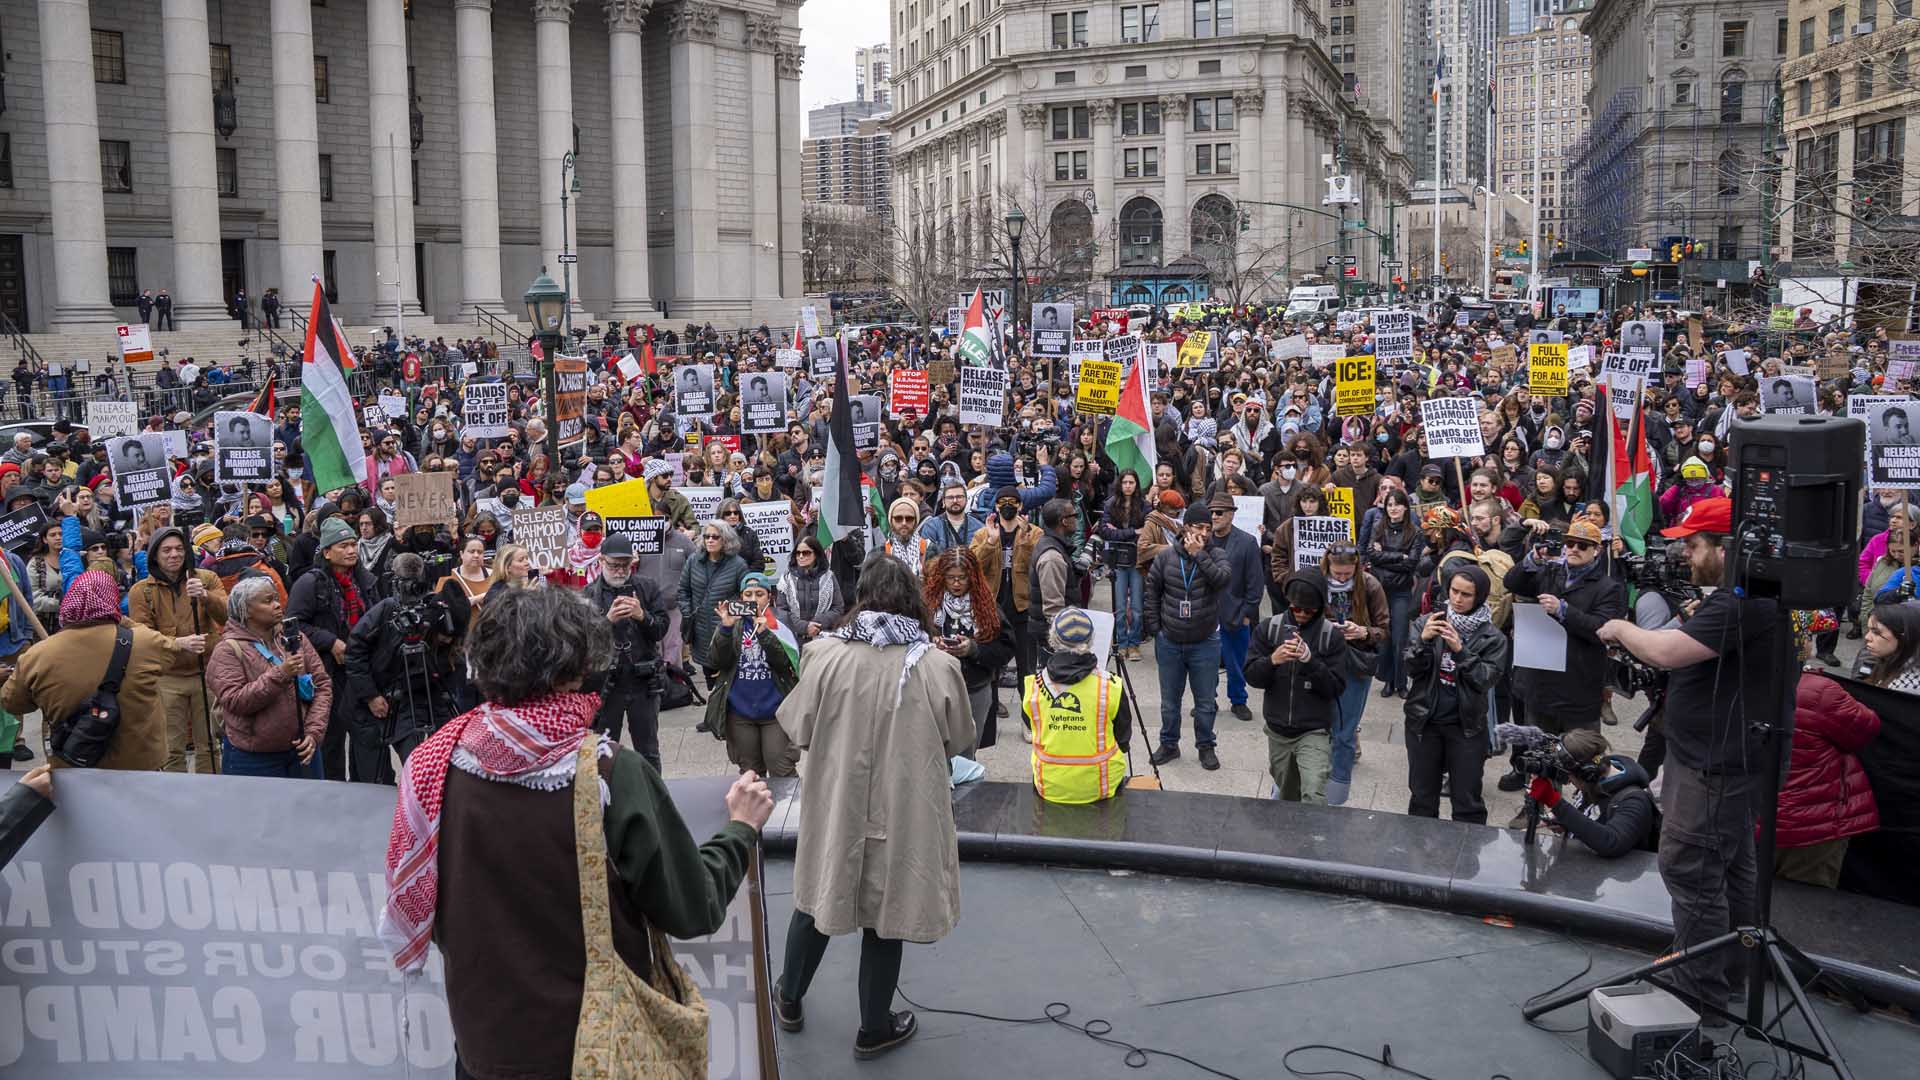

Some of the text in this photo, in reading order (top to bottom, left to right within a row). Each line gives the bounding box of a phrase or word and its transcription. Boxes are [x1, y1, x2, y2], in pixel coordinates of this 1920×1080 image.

[1095, 310, 1129, 321] TRUMP
[1377, 313, 1410, 324] HANDS
[1040, 331, 1063, 339] RELEASE
[1037, 338, 1067, 346] MAHMOUD
[1086, 341, 1101, 351] OFF
[1108, 336, 1138, 349] HANDS
[1377, 336, 1411, 346] RELEASE
[1110, 345, 1138, 355] OFF
[1377, 344, 1410, 353] MAHMOUD
[1537, 346, 1560, 356] FULL
[1377, 350, 1410, 358] KHALIL
[1532, 357, 1566, 367] RIGHTS
[1606, 356, 1624, 369] ICE
[1629, 359, 1650, 373] OFF
[963, 368, 1004, 382] RELEASE
[1083, 369, 1101, 378] ARE
[1102, 371, 1118, 381] THE
[1339, 361, 1372, 382] ICE:
[1532, 371, 1566, 381] FOR ALL
[962, 380, 1003, 391] MAHMOUD
[466, 385, 506, 398] HANDS
[683, 391, 706, 399] RELEASE
[962, 387, 1002, 397] KHALIL
[1089, 388, 1108, 399] NOT
[1338, 388, 1373, 398] OUT OF OUR
[467, 397, 505, 405] OFF
[681, 398, 710, 406] MAHMOUD
[961, 397, 1002, 409] HANDS OFF
[1423, 399, 1474, 413] RELEASE
[1612, 397, 1635, 406] STUDEN
[93, 402, 129, 413] RELEASE
[479, 403, 506, 411] STUDENTS
[751, 403, 777, 412] RELEASE
[973, 406, 1001, 415] STUDENTS
[1775, 406, 1806, 415] RELEASE
[1851, 407, 1866, 415] OUR
[92, 412, 137, 424] MAHMOUD
[467, 411, 507, 425] ICE OFF
[748, 411, 781, 420] MAHMOUD
[1425, 410, 1475, 422] MAHMOUD
[754, 418, 775, 427] KHALIL
[1426, 419, 1477, 428] KHALIL
[97, 424, 132, 435] NOW!
[1428, 429, 1479, 439] HANDS OFF
[1429, 436, 1480, 446] OUR STUDENTS
[230, 449, 262, 459] RELEASE
[225, 458, 266, 468] MAHMOUD
[1878, 457, 1920, 468] MAHMOU
[232, 467, 259, 477] KHALIL
[127, 471, 158, 485] RELEASE
[123, 479, 165, 495] MAHMOUD
[132, 491, 159, 502] KHALIL
[398, 490, 447, 509] NEVER
[758, 509, 790, 518] ALAMO
[1330, 503, 1351, 515] HTS
[514, 509, 563, 525] RELEASE
[747, 516, 780, 525] UNITED
[607, 519, 665, 531] YOU CANNOT
[1298, 519, 1348, 533] RELEASE
[2, 527, 31, 544] KHALIL
[512, 521, 566, 541] MAHMOUD
[757, 526, 790, 536] DARITY
[1298, 531, 1348, 543] MAHMOUD
[632, 542, 660, 553] OCIDE
[759, 538, 791, 548] MOUD
[1298, 541, 1327, 550] KHA
[761, 546, 791, 555] ALIL
[526, 548, 567, 570] NOW
[1299, 555, 1322, 565] HAND
[738, 671, 772, 681] BEAST
[1050, 714, 1085, 722] Veterans
[1048, 723, 1060, 731] For
